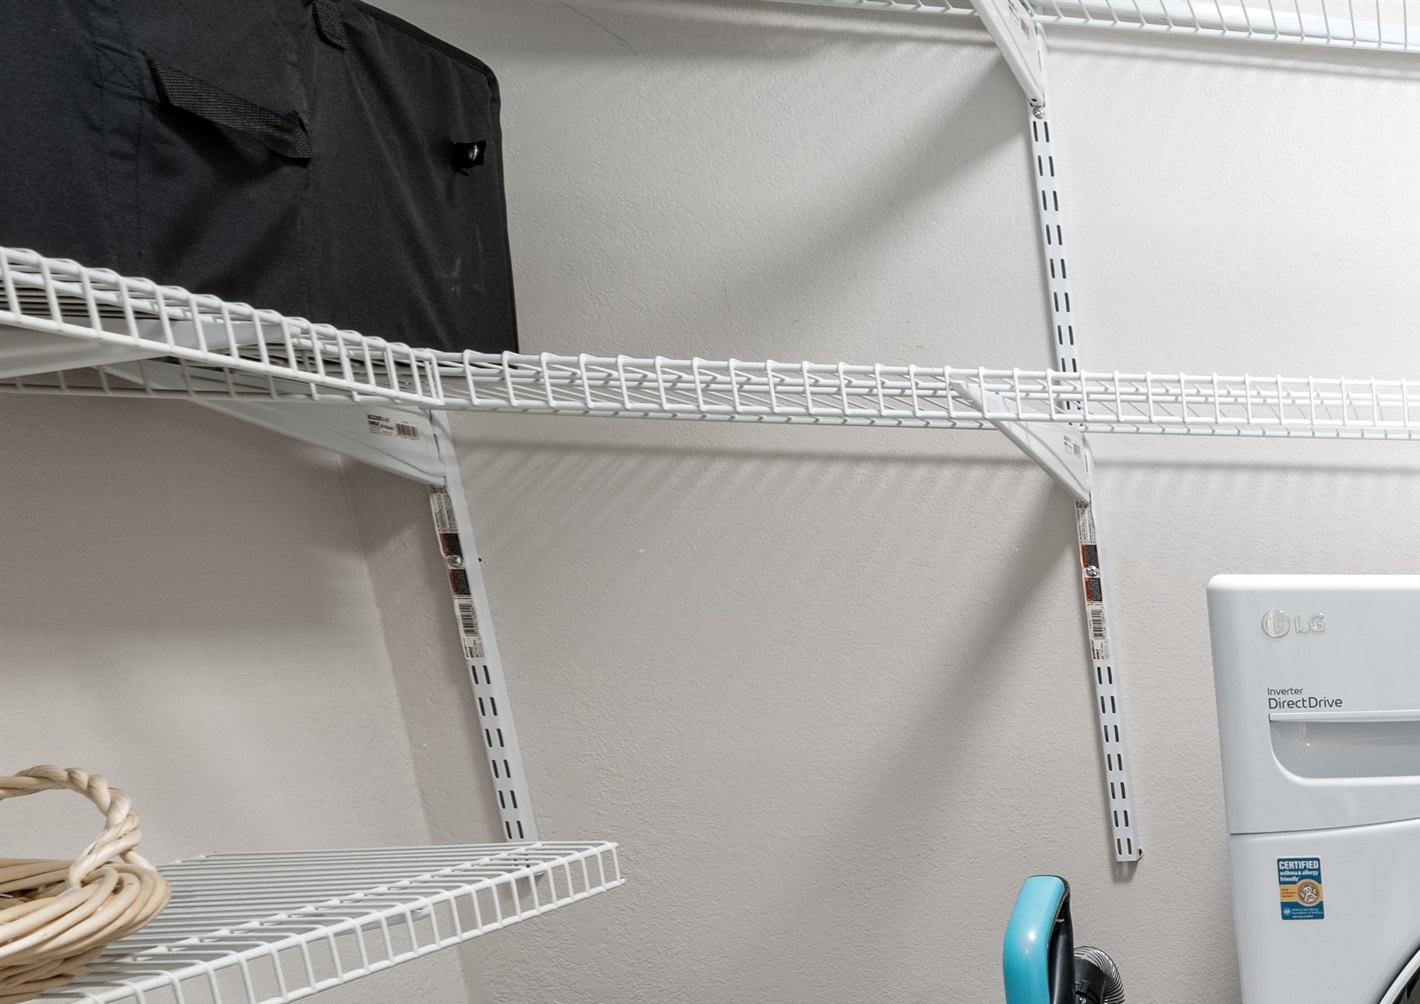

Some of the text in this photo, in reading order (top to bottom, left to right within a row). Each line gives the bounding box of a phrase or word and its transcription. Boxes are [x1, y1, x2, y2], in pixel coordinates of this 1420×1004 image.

[1294, 612, 1326, 633] LG
[1267, 687, 1303, 695] Inverter
[1279, 861, 1319, 869] CERTIFIED
